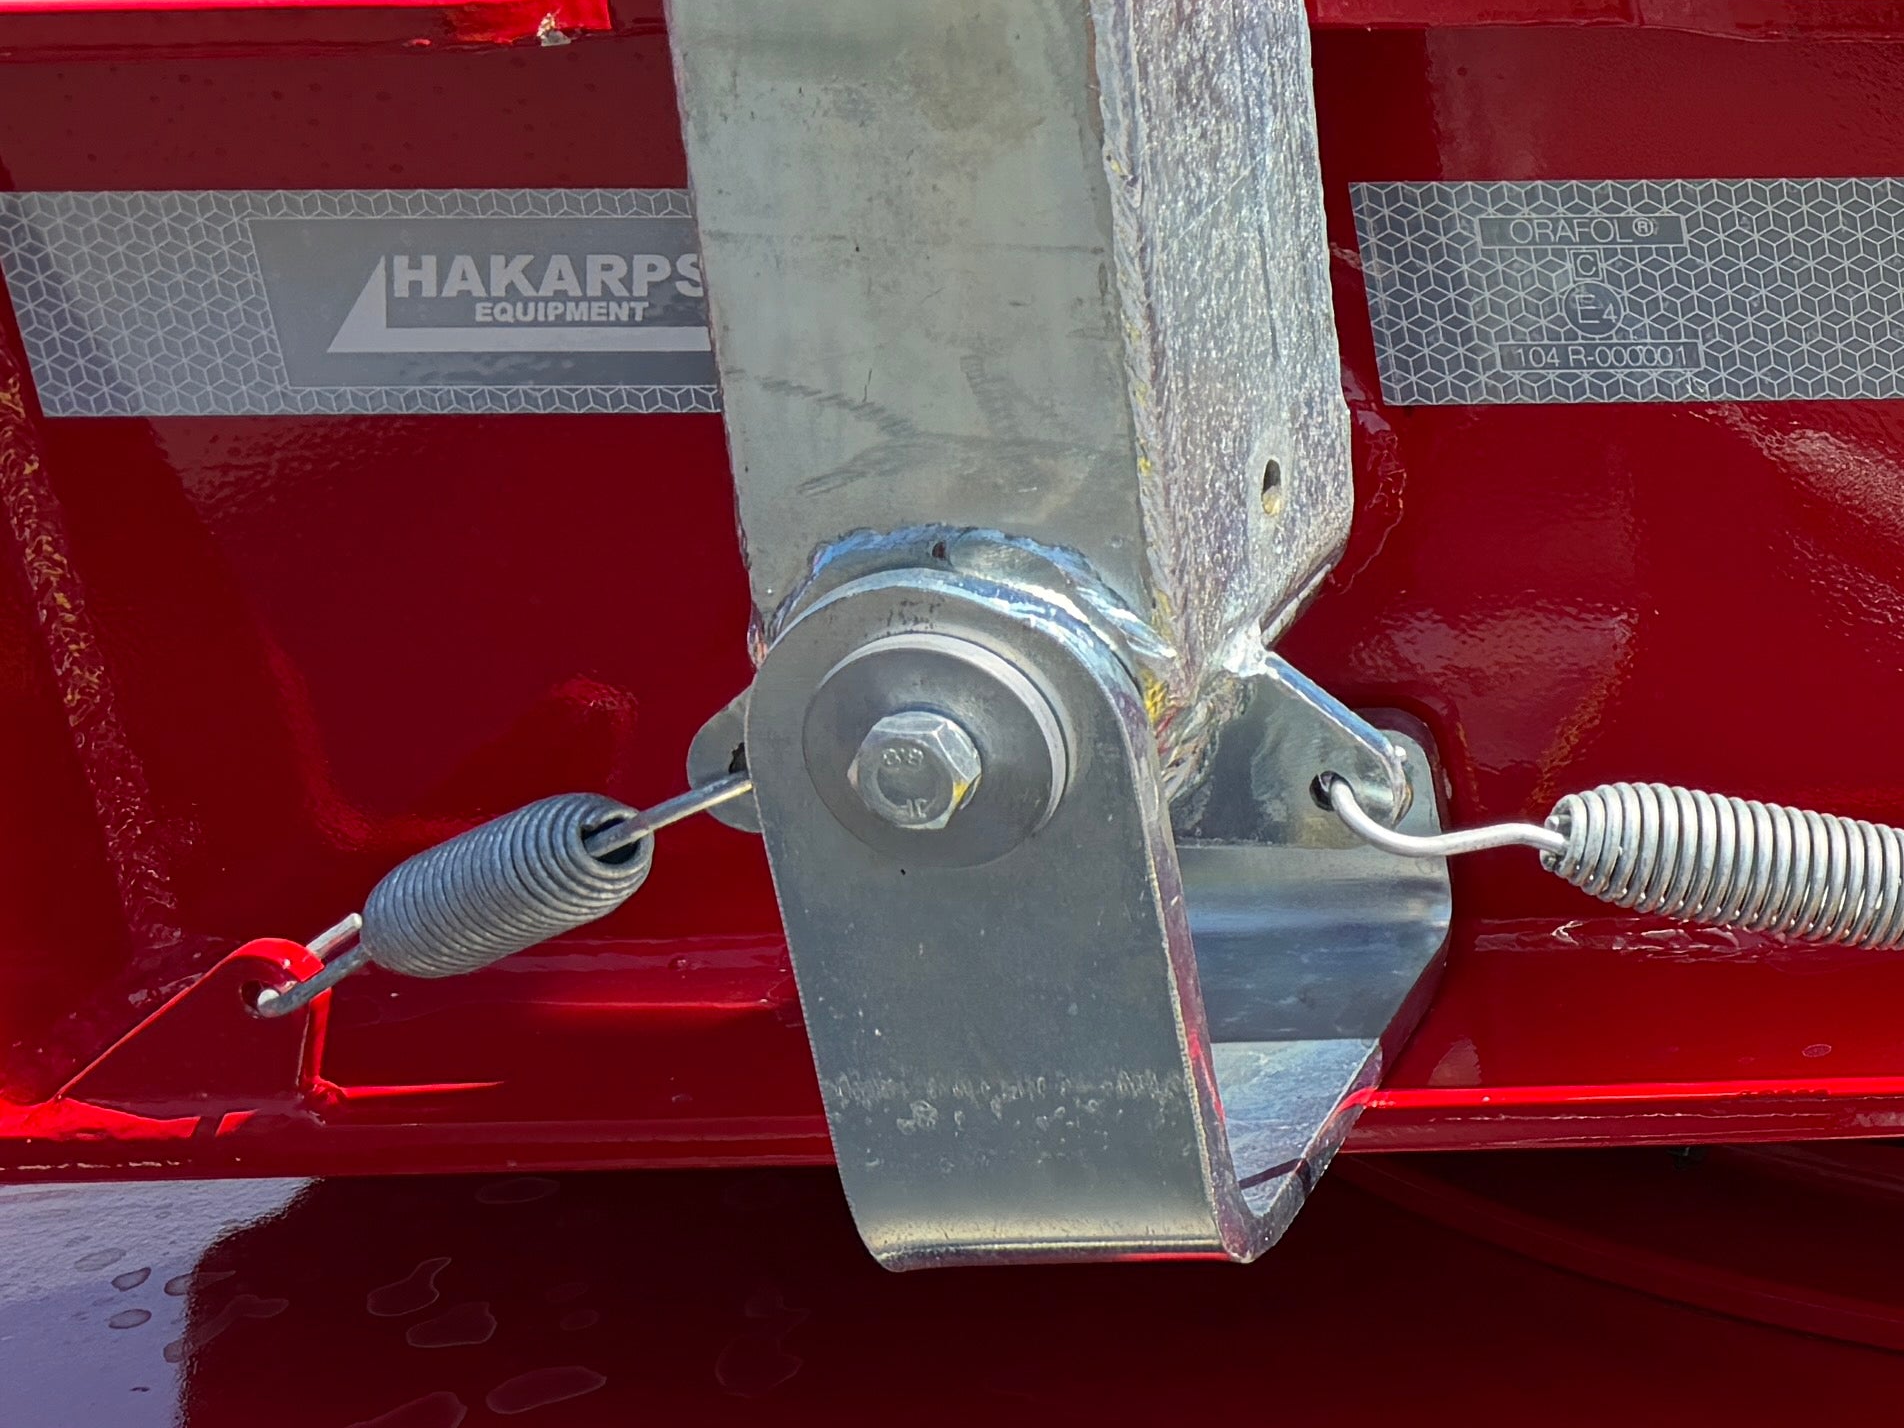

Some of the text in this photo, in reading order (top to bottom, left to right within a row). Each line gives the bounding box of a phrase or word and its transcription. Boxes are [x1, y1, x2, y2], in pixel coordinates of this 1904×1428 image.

[393, 254, 704, 297] HAKARPS
[1577, 254, 1596, 276] C
[475, 301, 649, 323] EQUIPMENT
[1515, 346, 1560, 367] 104
